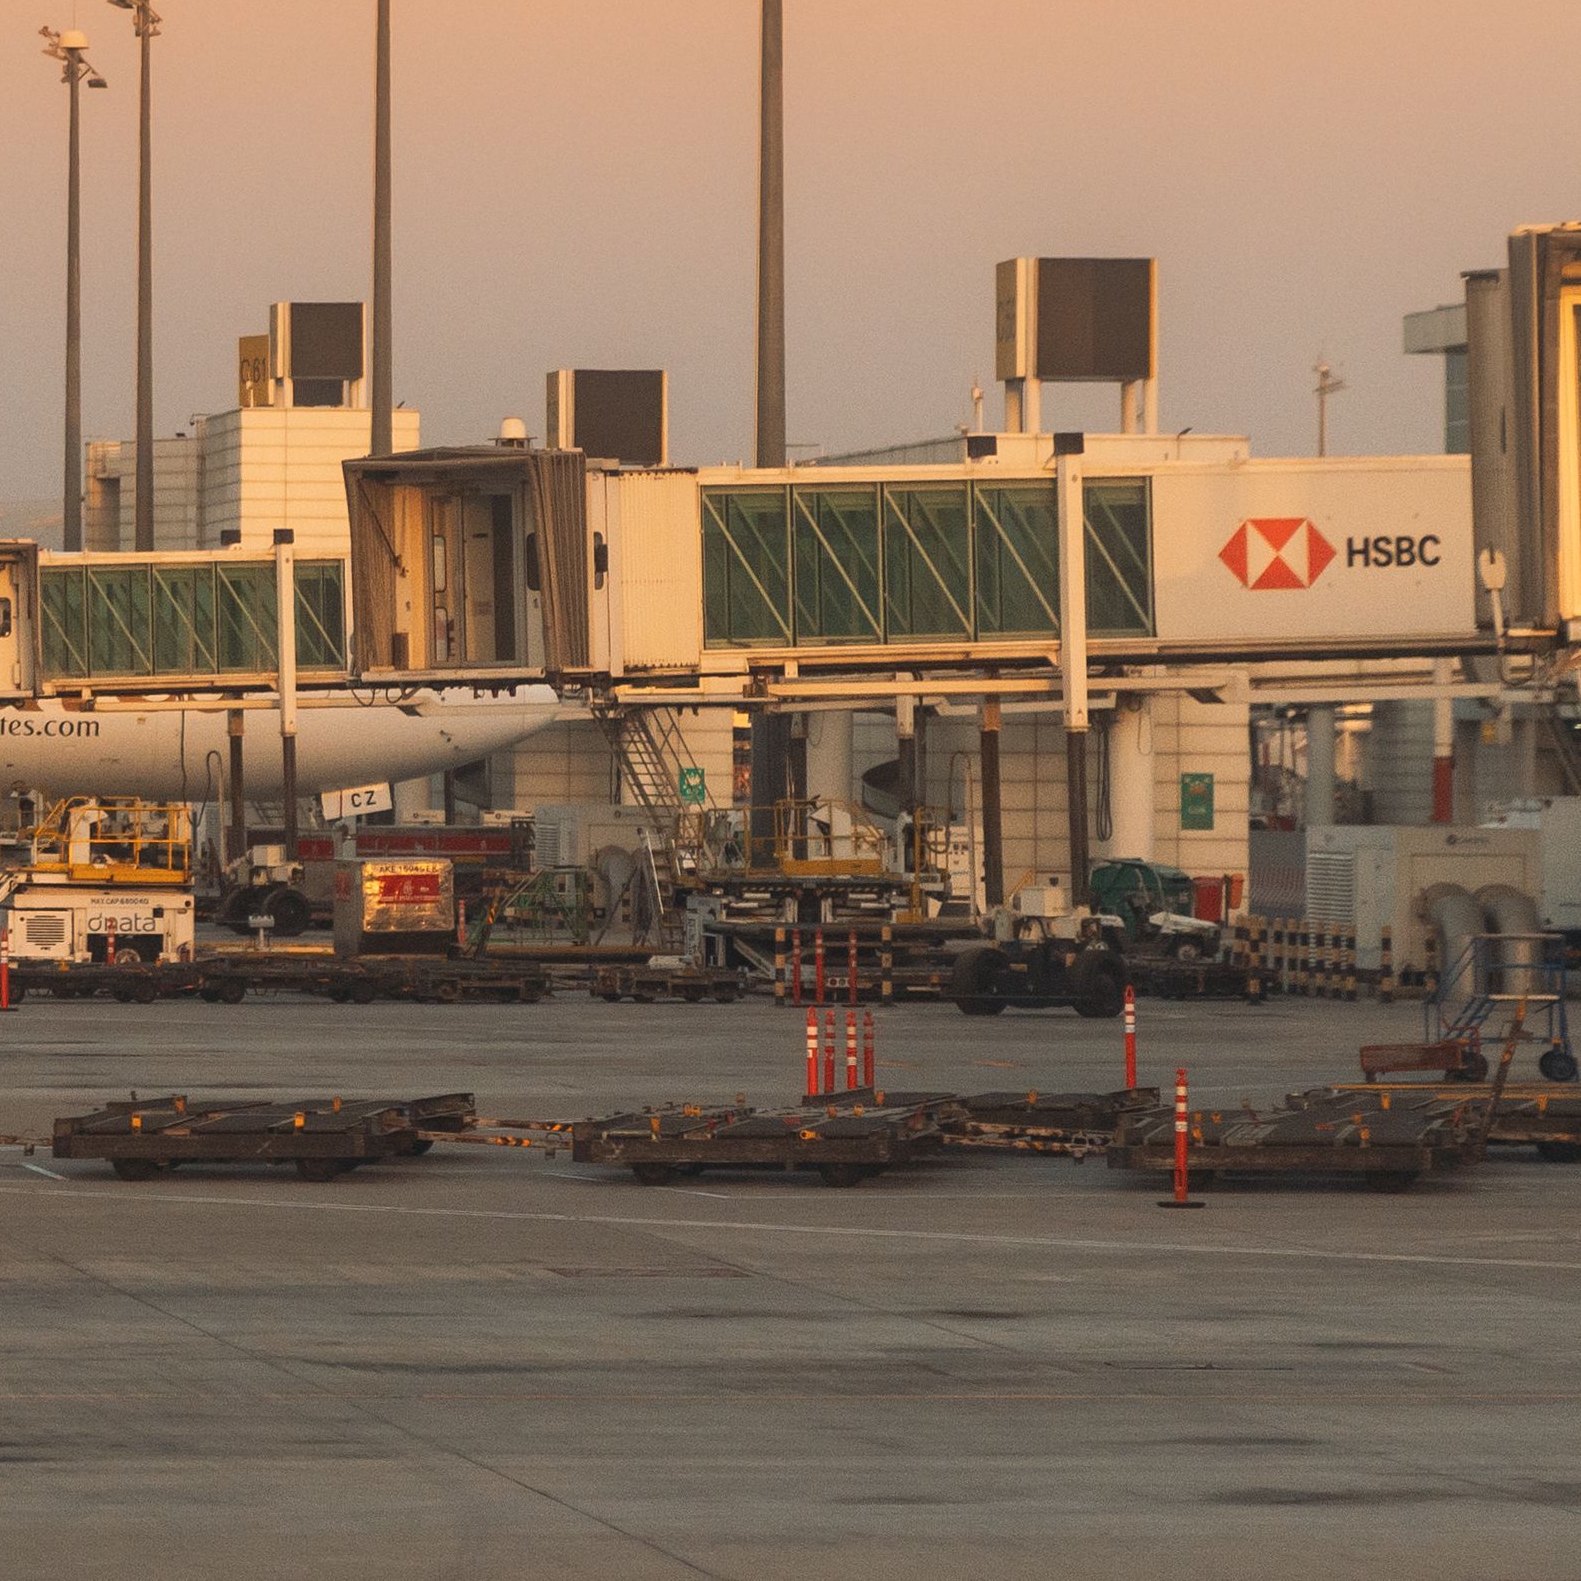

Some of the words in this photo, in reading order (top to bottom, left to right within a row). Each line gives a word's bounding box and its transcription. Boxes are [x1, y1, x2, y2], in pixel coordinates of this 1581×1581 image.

[1346, 534, 1442, 568] HSBC
[350, 790, 377, 808] CZ
[87, 912, 156, 932] dnata
